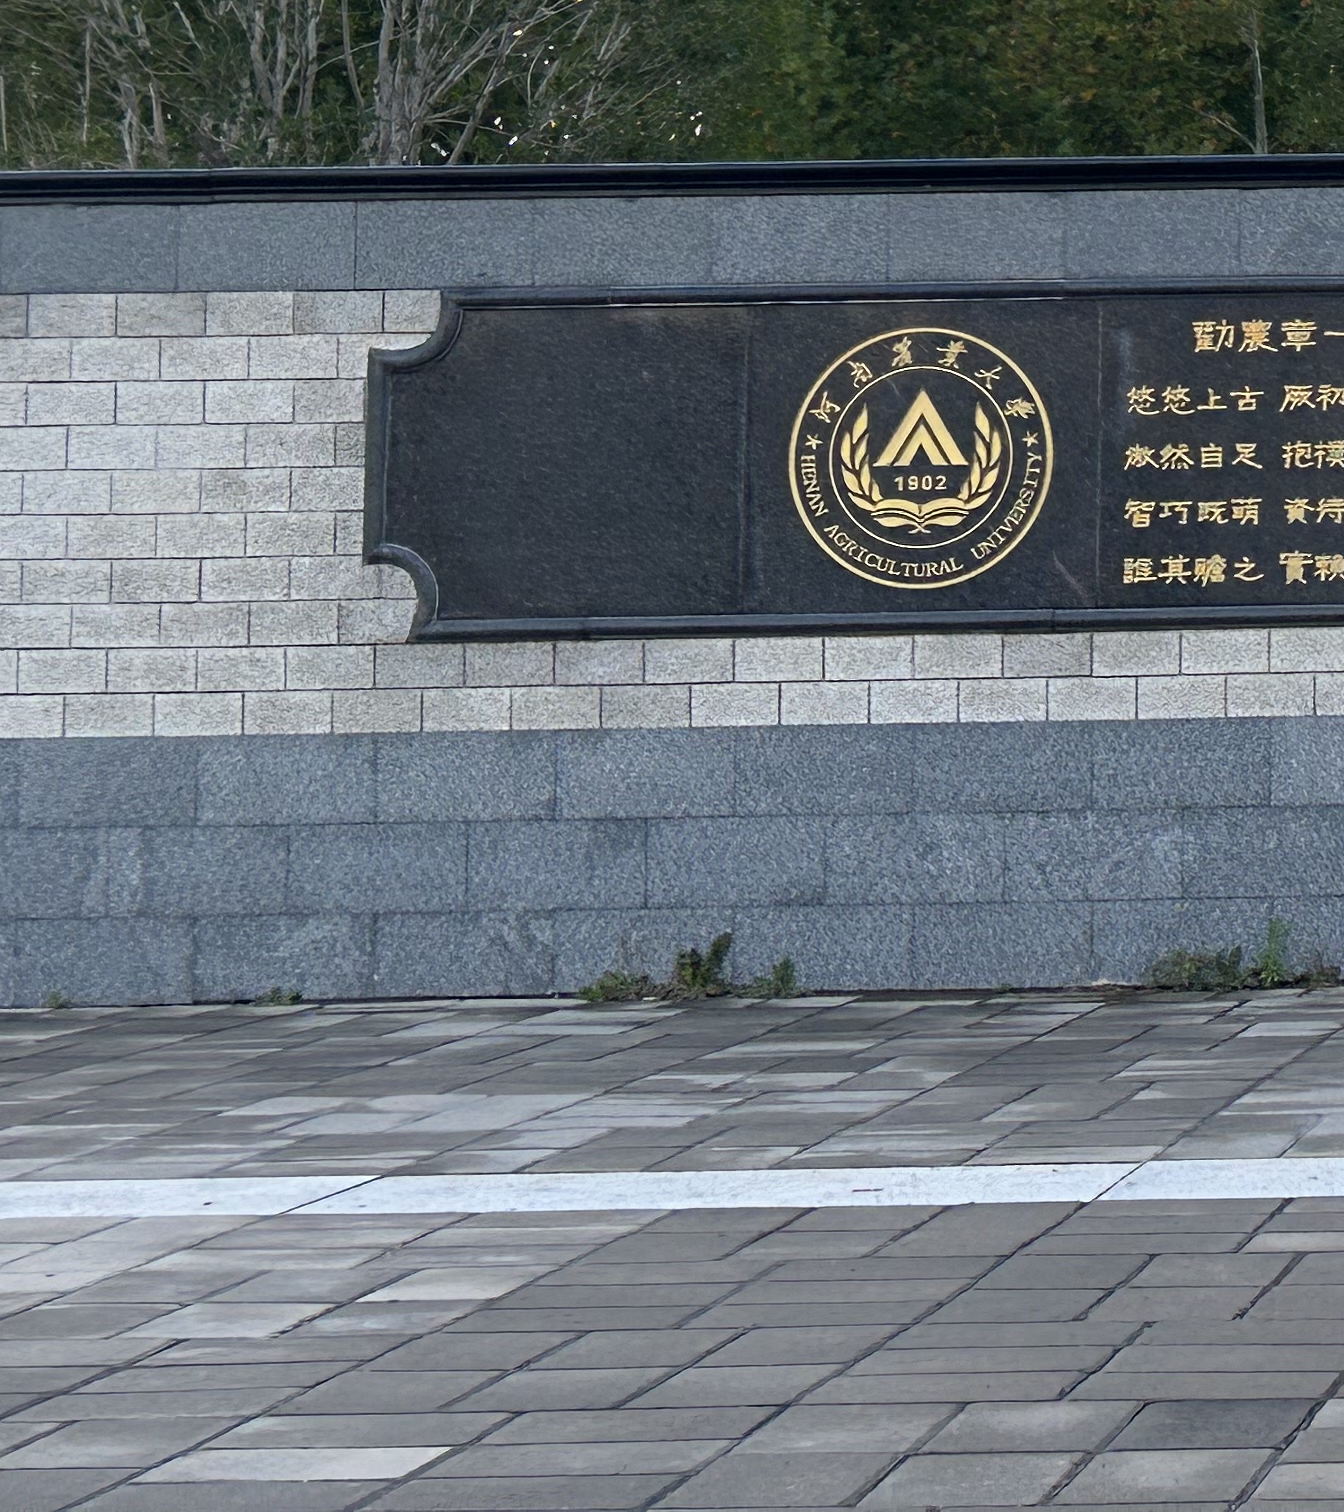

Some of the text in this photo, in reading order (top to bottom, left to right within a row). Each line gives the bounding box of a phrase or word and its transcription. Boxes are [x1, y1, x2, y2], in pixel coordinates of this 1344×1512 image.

[1127, 384, 1264, 416] 悠悠上古
[894, 475, 948, 492] 1902
[801, 451, 1043, 578] HENAN AGRICULTURAL UNIVERSITY
[1123, 496, 1263, 529] 智巧既萌
[1122, 553, 1265, 586] 誰其贍之
